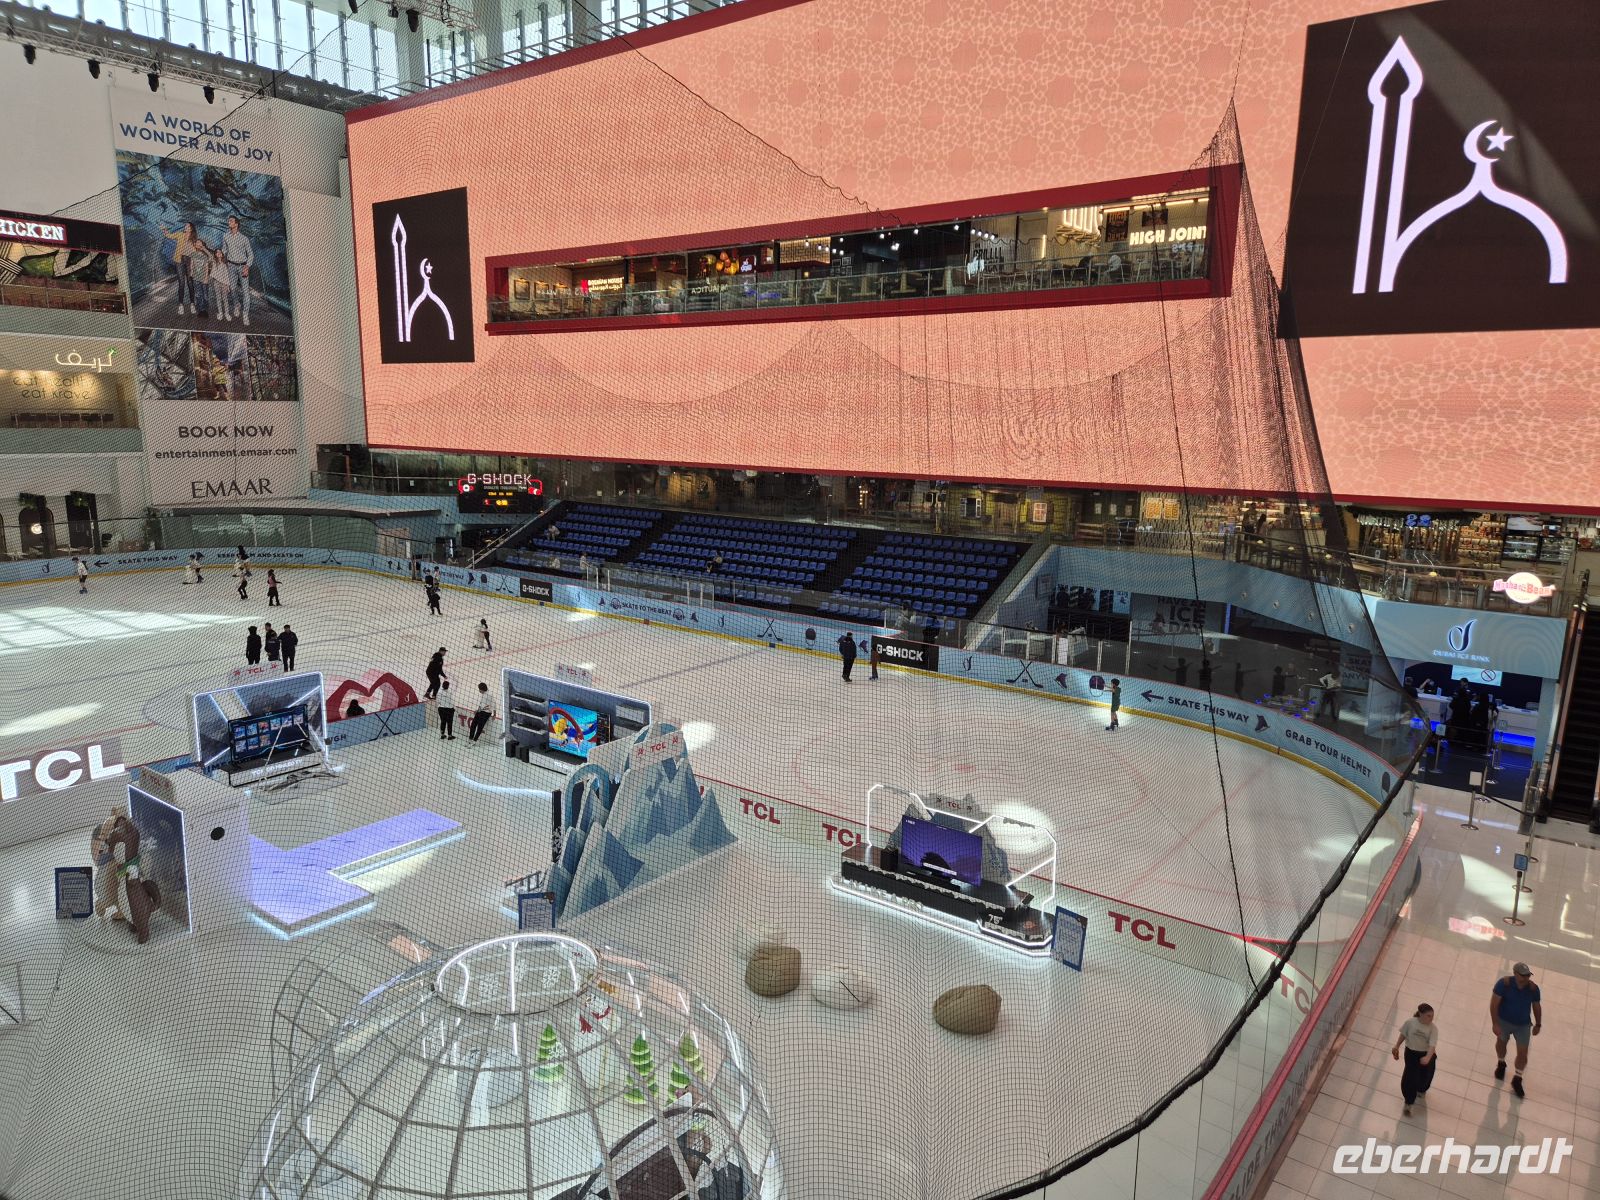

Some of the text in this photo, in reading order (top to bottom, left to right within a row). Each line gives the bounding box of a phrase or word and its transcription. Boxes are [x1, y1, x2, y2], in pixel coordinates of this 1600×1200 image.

[144, 111, 251, 143] A WORLD OF
[119, 122, 273, 162] WONDER AND JOY
[1129, 229, 1166, 246] HIGH
[21, 387, 90, 400] eat krave
[178, 425, 274, 438] BOOK NOW
[155, 447, 298, 459] entertainment.emaar.com
[191, 478, 273, 499] EMAAR
[467, 473, 533, 485] G-SHOCK
[620, 601, 673, 616] SKATE TO THE BEAT
[1170, 605, 1206, 624] ICE
[876, 643, 924, 662] G-SHOCK
[247, 667, 264, 675] TCL
[1167, 696, 1250, 723] SKATE THIS WAY
[650, 741, 667, 752] TCL
[1285, 729, 1372, 778] GRAB YOUR HELMET
[0, 744, 126, 800] TCL
[739, 797, 781, 825] TCL
[1107, 910, 1177, 950] TCL
